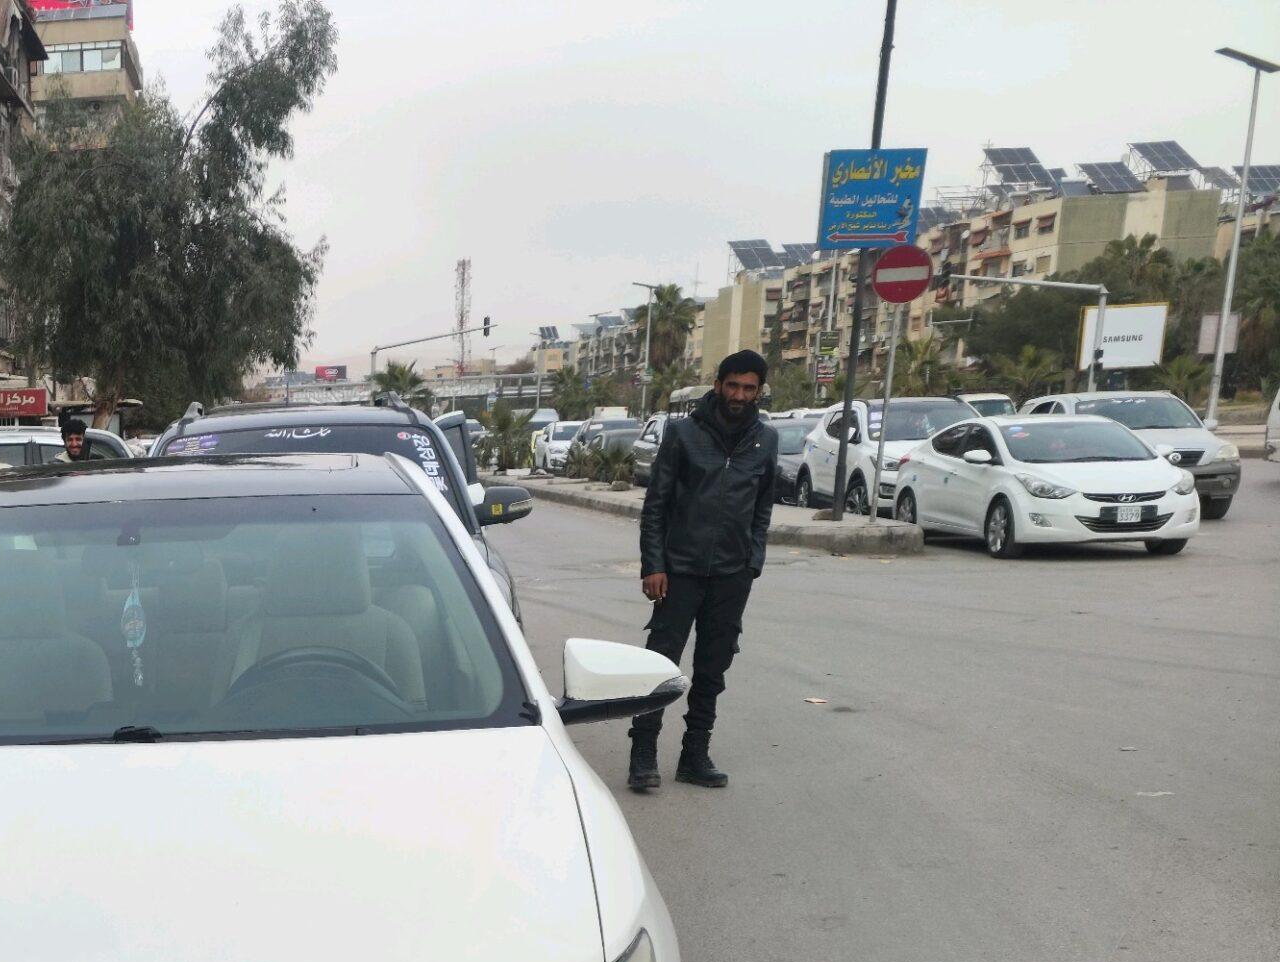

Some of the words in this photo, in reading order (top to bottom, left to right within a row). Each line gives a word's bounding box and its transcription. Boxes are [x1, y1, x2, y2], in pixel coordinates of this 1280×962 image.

[890, 157, 920, 187] مخبر
[830, 192, 860, 207] الطبية
[1103, 334, 1144, 343] SAMSUNG
[6, 392, 36, 406] مركز
